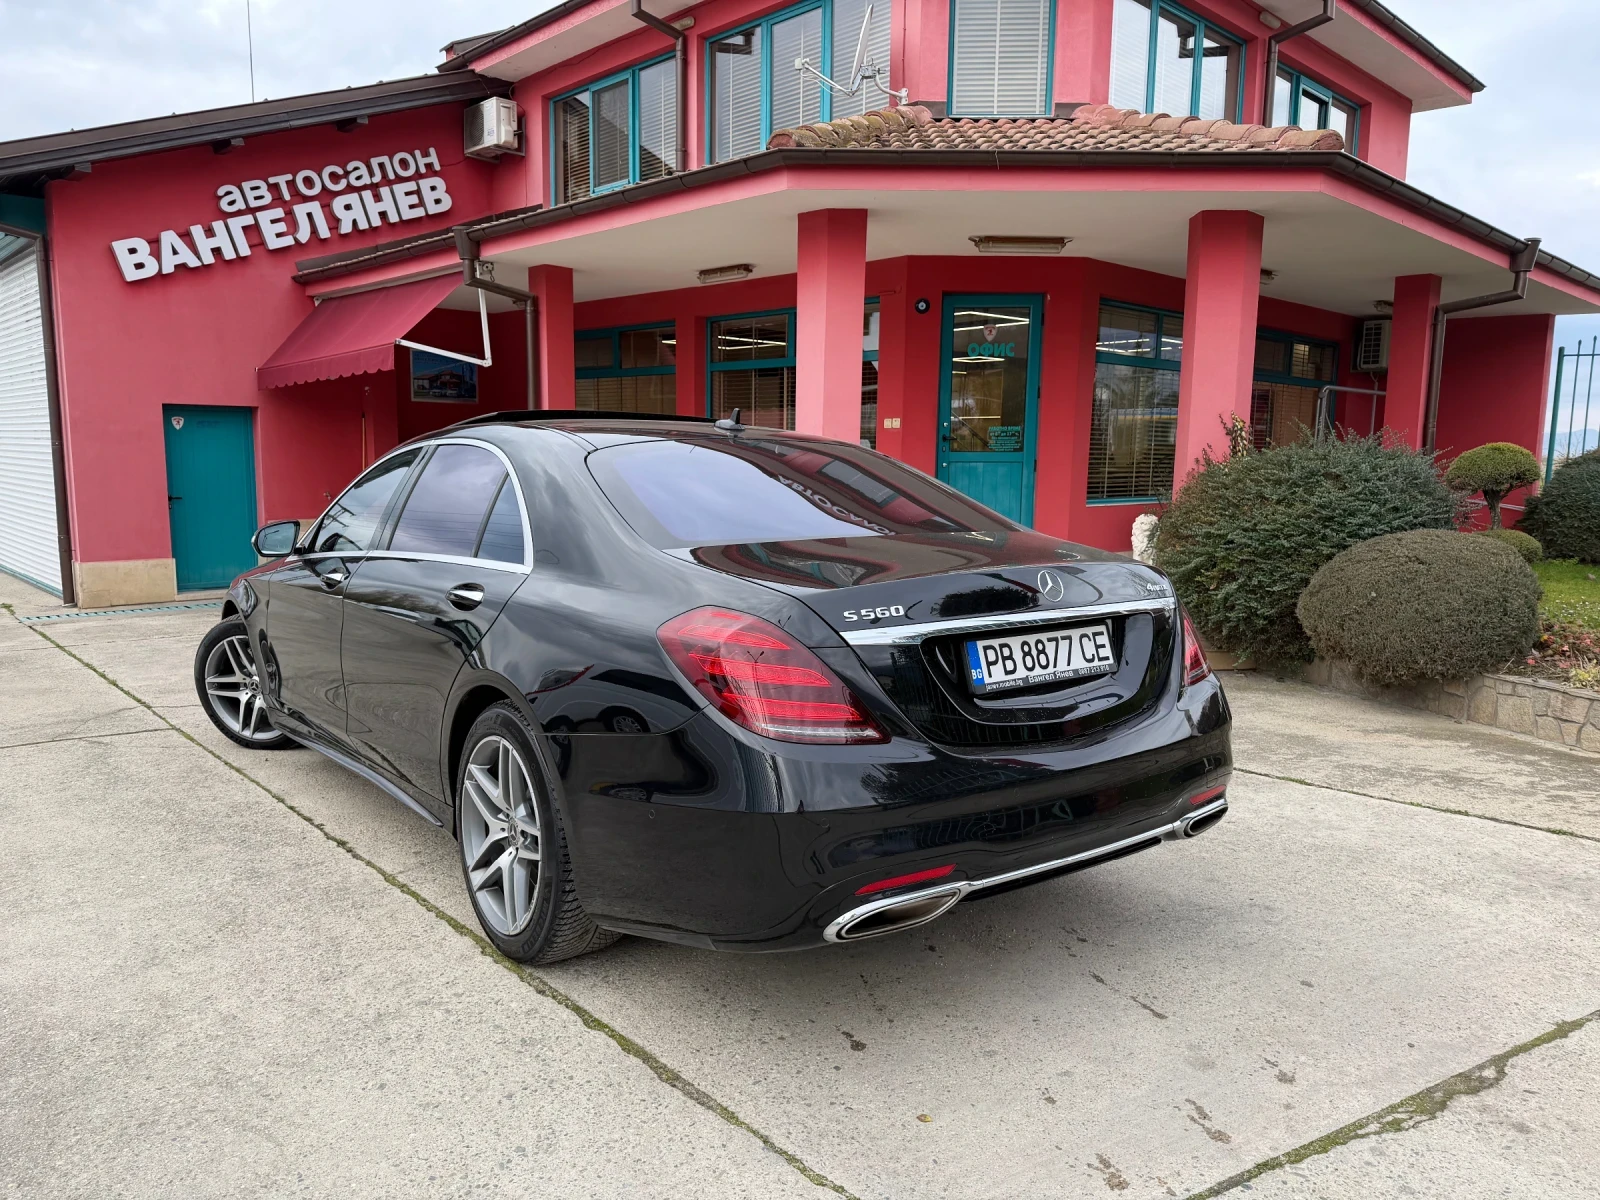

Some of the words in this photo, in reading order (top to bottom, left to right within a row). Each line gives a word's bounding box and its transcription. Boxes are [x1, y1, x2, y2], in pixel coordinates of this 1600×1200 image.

[216, 147, 441, 213] автосалон
[110, 201, 331, 282] ВАНГЕЛ
[330, 176, 453, 234] ЯНЕВ
[967, 342, 1015, 357] ОФИС
[843, 610, 859, 622] S
[860, 605, 905, 620] 560
[982, 642, 1018, 679] PB
[1020, 638, 1072, 672] 8877
[1078, 631, 1110, 664] CE
[972, 669, 983, 679] BG
[1055, 669, 1074, 680] Янев
